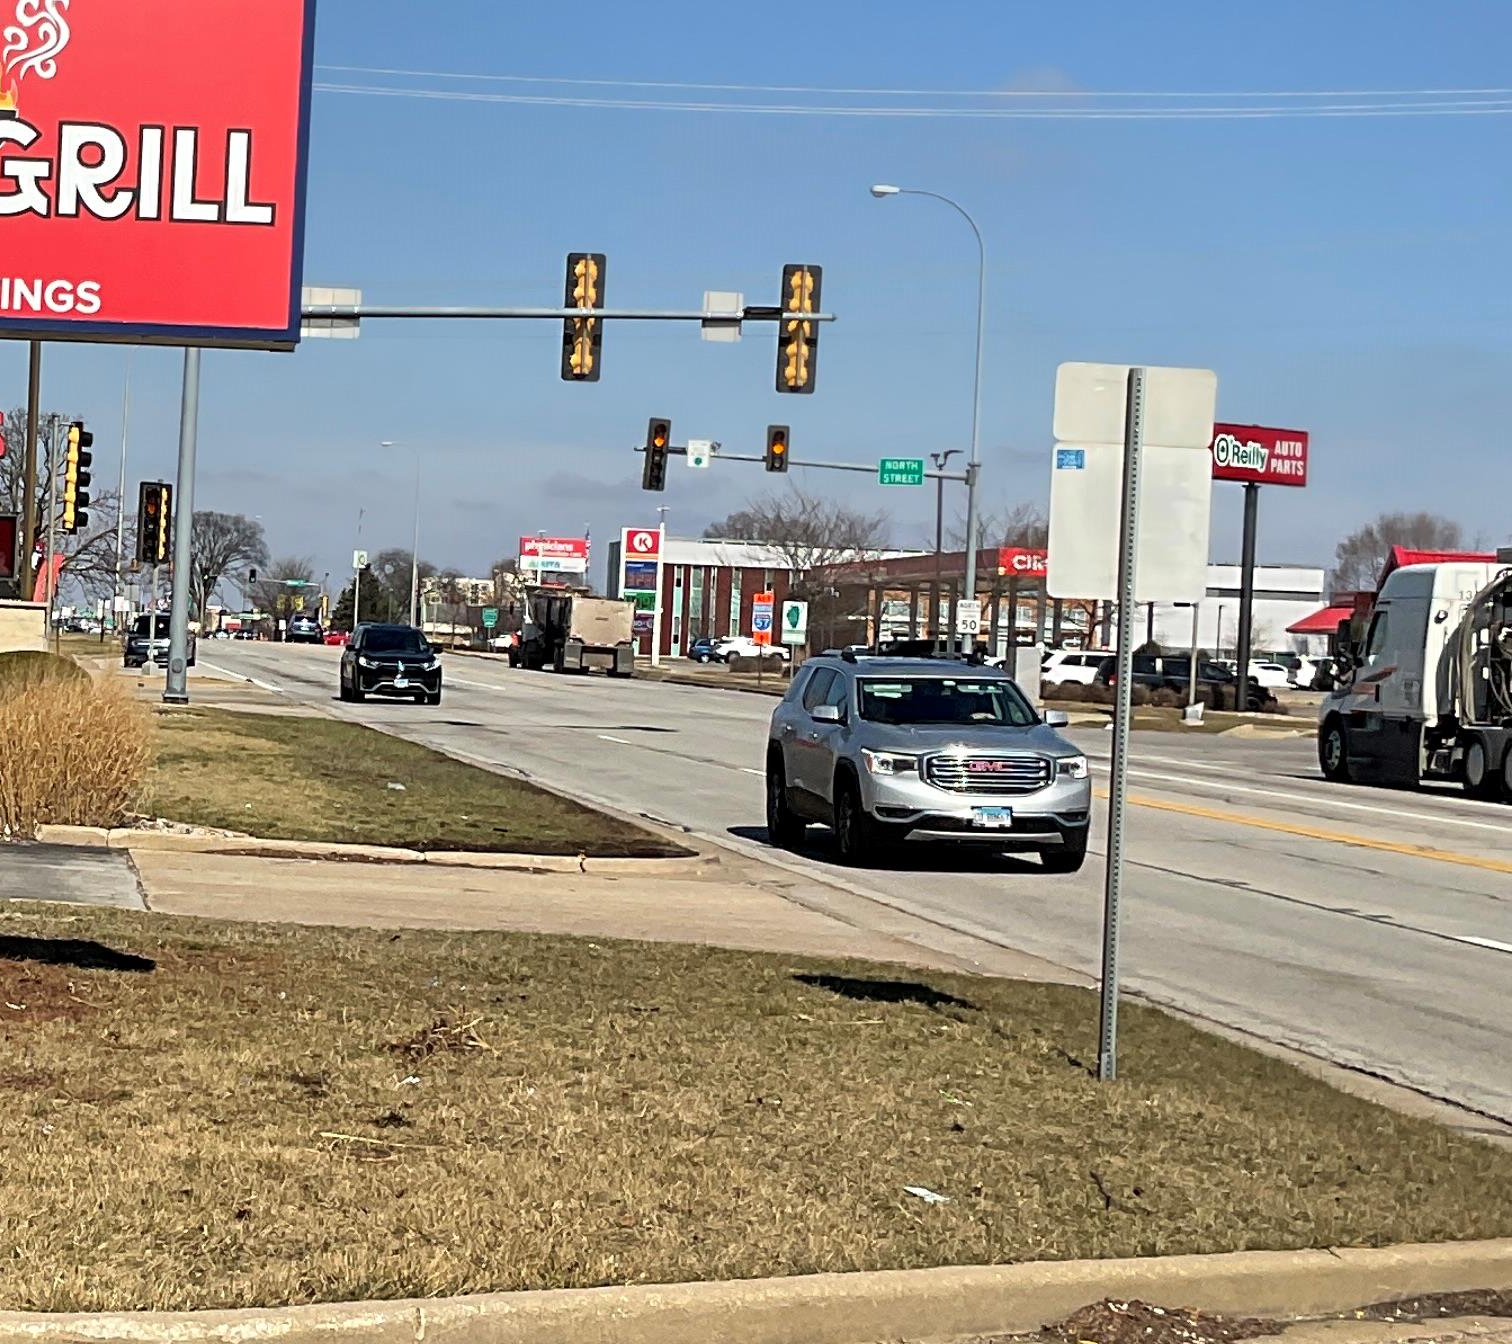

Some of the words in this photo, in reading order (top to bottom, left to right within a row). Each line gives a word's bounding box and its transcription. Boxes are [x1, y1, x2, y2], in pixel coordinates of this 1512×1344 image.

[1215, 435, 1268, 472] O'Reilly
[1274, 440, 1303, 457] AUTO
[885, 460, 919, 471] NORTH
[1270, 458, 1304, 476] PARTS
[883, 473, 920, 484] STREET
[755, 618, 770, 628] 57
[962, 619, 977, 631] 50
